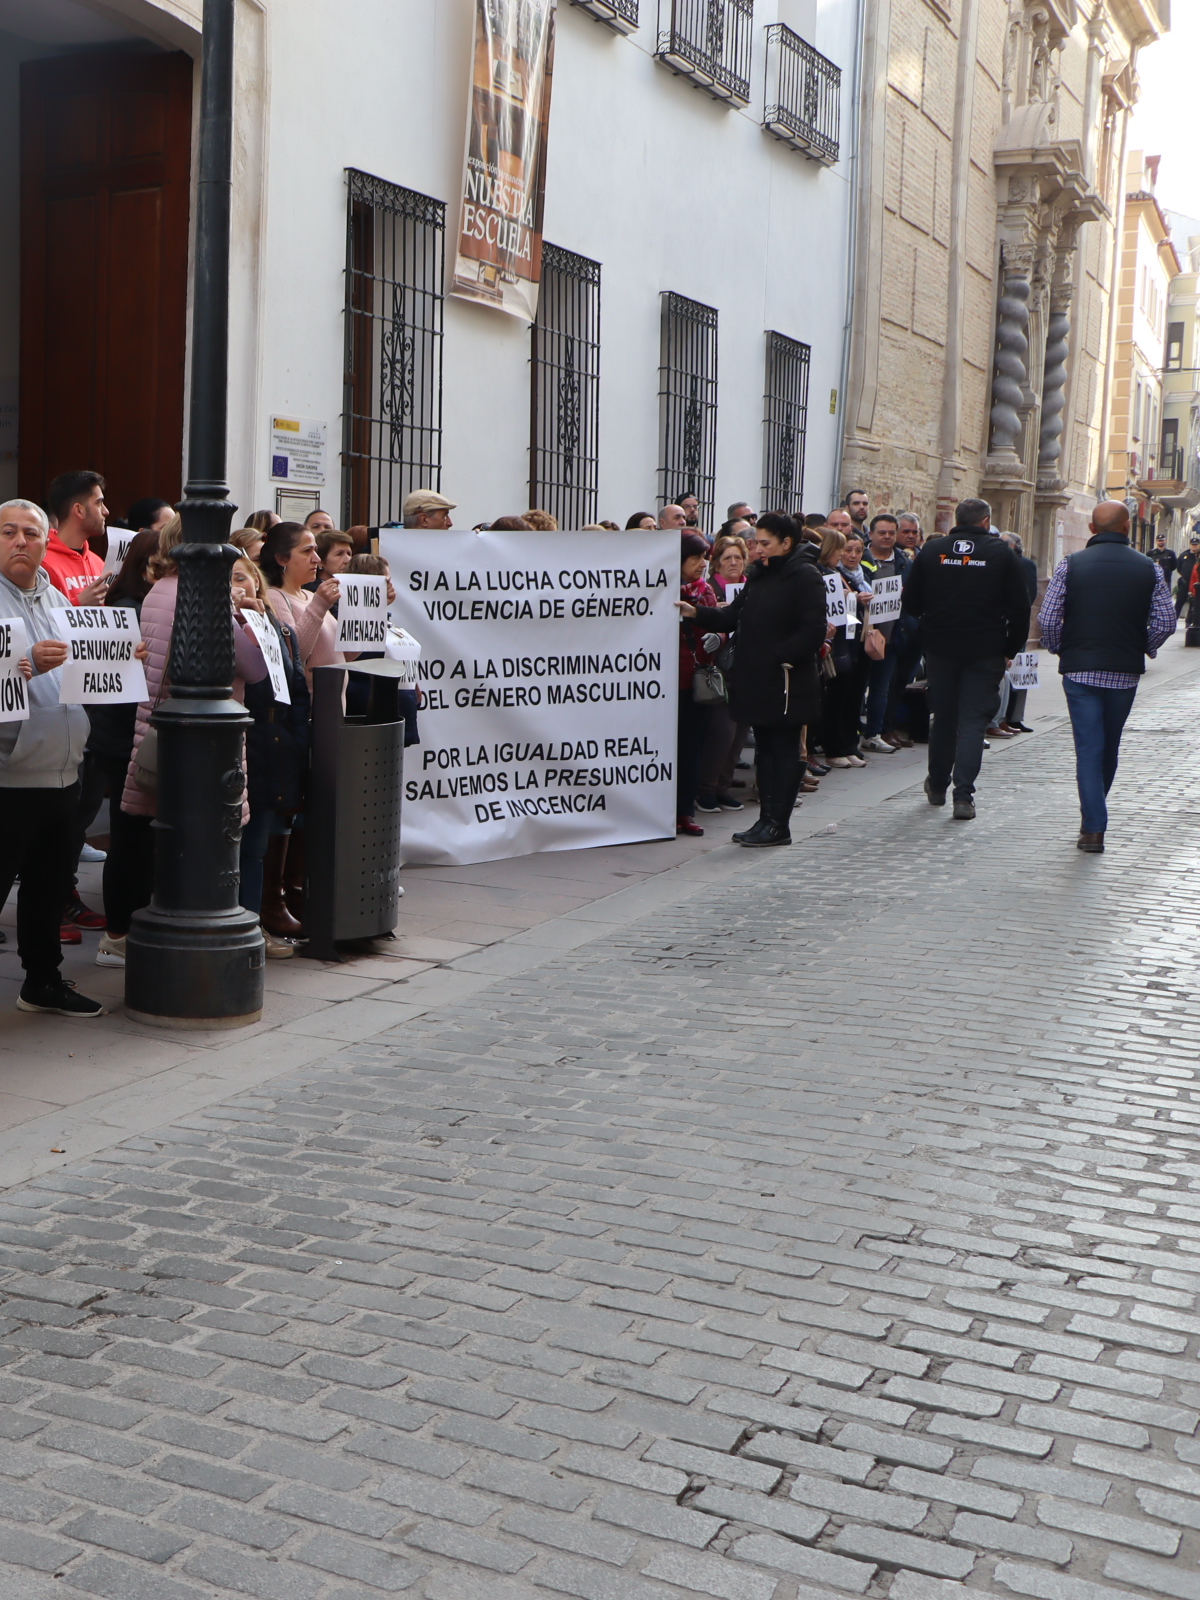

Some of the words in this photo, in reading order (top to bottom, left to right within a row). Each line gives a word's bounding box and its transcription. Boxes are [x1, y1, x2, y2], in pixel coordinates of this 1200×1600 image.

[464, 168, 533, 228] NUESTRA
[462, 203, 531, 261] ESCUELA
[957, 541, 971, 552] TP
[939, 554, 962, 566] TALLER
[409, 571, 428, 591] SI
[434, 571, 449, 591] A
[455, 571, 481, 591] LA
[486, 571, 554, 591] LUCHA
[558, 569, 638, 590] CONTRA
[645, 569, 668, 588] LA
[874, 583, 883, 595] NO
[886, 580, 899, 592] MAS
[347, 585, 359, 607] NO
[363, 586, 380, 608] MAS
[423, 600, 534, 621] VIOLENCIA
[539, 600, 564, 619] DE
[571, 593, 654, 618] GÉNERO.
[870, 599, 901, 616] MENTIRAS
[65, 609, 109, 629] BASTA
[115, 610, 129, 629] DE
[340, 620, 385, 642] AMENAZAS
[70, 639, 133, 661] DENUNCIAS
[1026, 654, 1033, 667] DE
[418, 659, 445, 681] NO
[450, 659, 467, 680] A
[474, 658, 498, 680] LA
[502, 648, 661, 678] DISCRIMINACIÓN
[83, 673, 123, 693] FALSAS
[454, 682, 541, 708] GÉNERO
[548, 680, 666, 705] MASCULINO.
[422, 748, 461, 770] POR
[466, 745, 489, 766] LA
[494, 739, 599, 763] IGUALDAD
[604, 736, 659, 758] REAL,
[405, 772, 508, 801] SALVEMOS
[515, 770, 539, 790] LA
[544, 758, 673, 788] PRESUNCIÓN
[474, 801, 506, 823] DE
[506, 794, 606, 818] INOCENCIA
